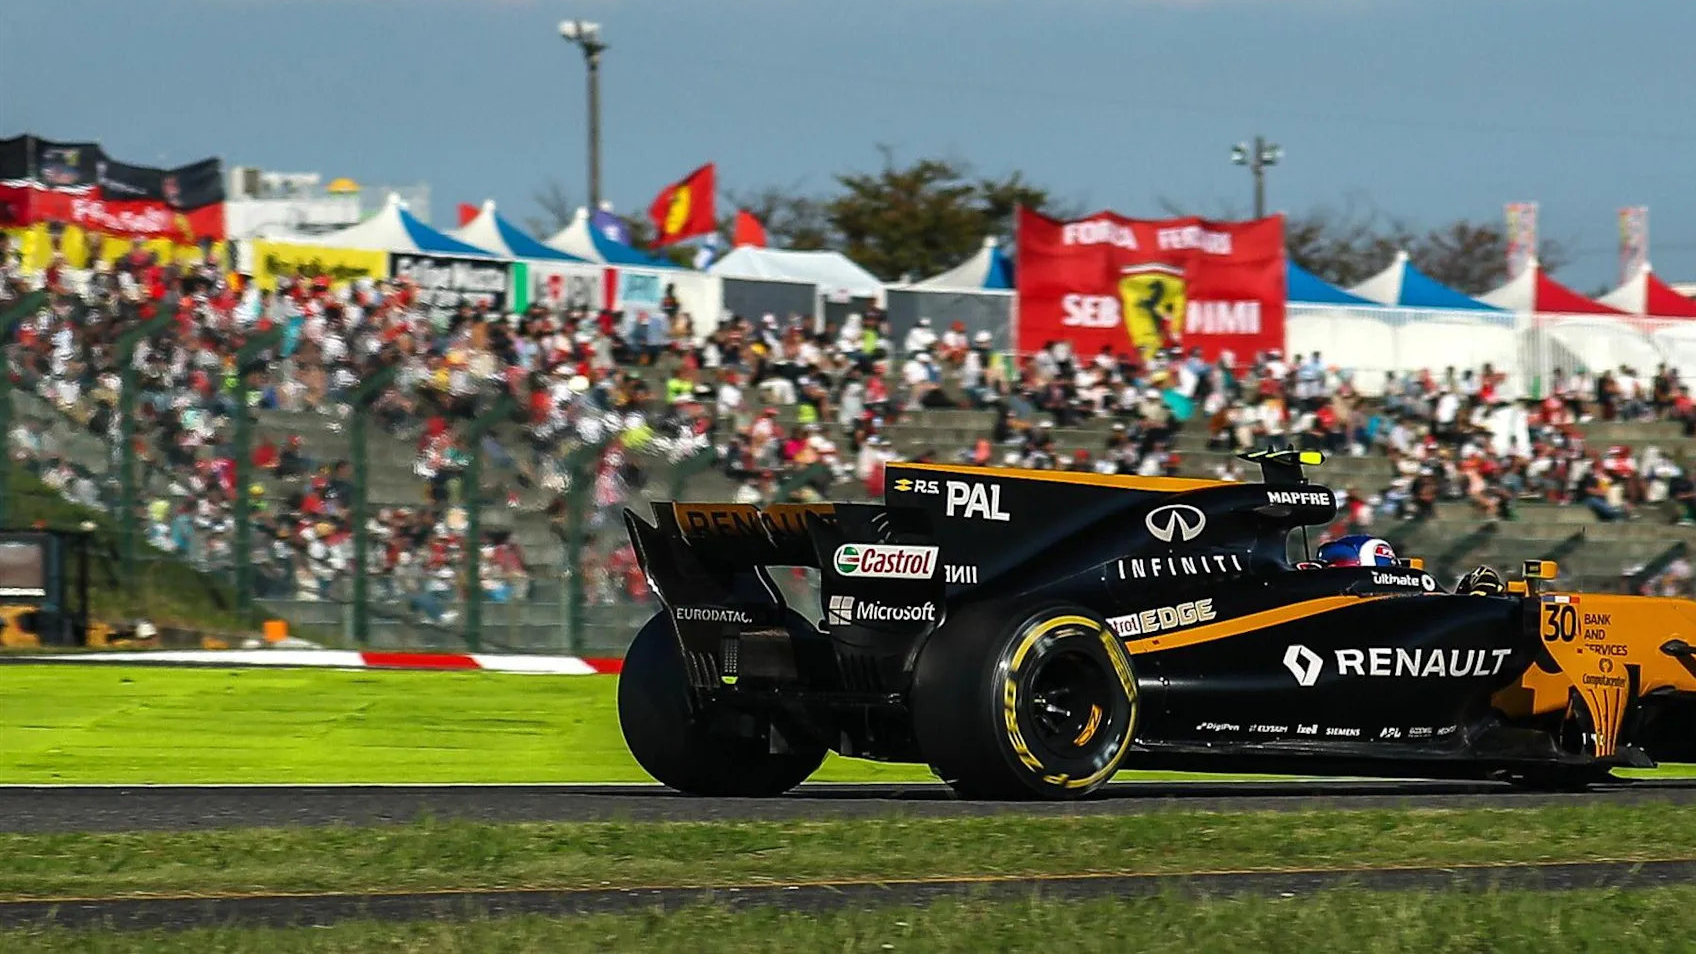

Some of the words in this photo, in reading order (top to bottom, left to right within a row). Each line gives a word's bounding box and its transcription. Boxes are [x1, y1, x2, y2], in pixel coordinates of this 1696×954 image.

[1061, 293, 1121, 328] SEB
[946, 481, 1010, 521] PAL
[1267, 491, 1330, 506] MAPFRE
[861, 548, 931, 575] Castrol
[1118, 555, 1242, 579] INFINITI
[857, 601, 935, 621] Microsoft
[1139, 598, 1217, 633] EDGE
[1544, 604, 1576, 642] 30
[1584, 613, 1611, 626] BANK
[1584, 629, 1606, 640] AND
[1334, 648, 1512, 677] RENAULT
[1585, 644, 1628, 657] ERVICES
[1325, 726, 1361, 737] SIEMENS
